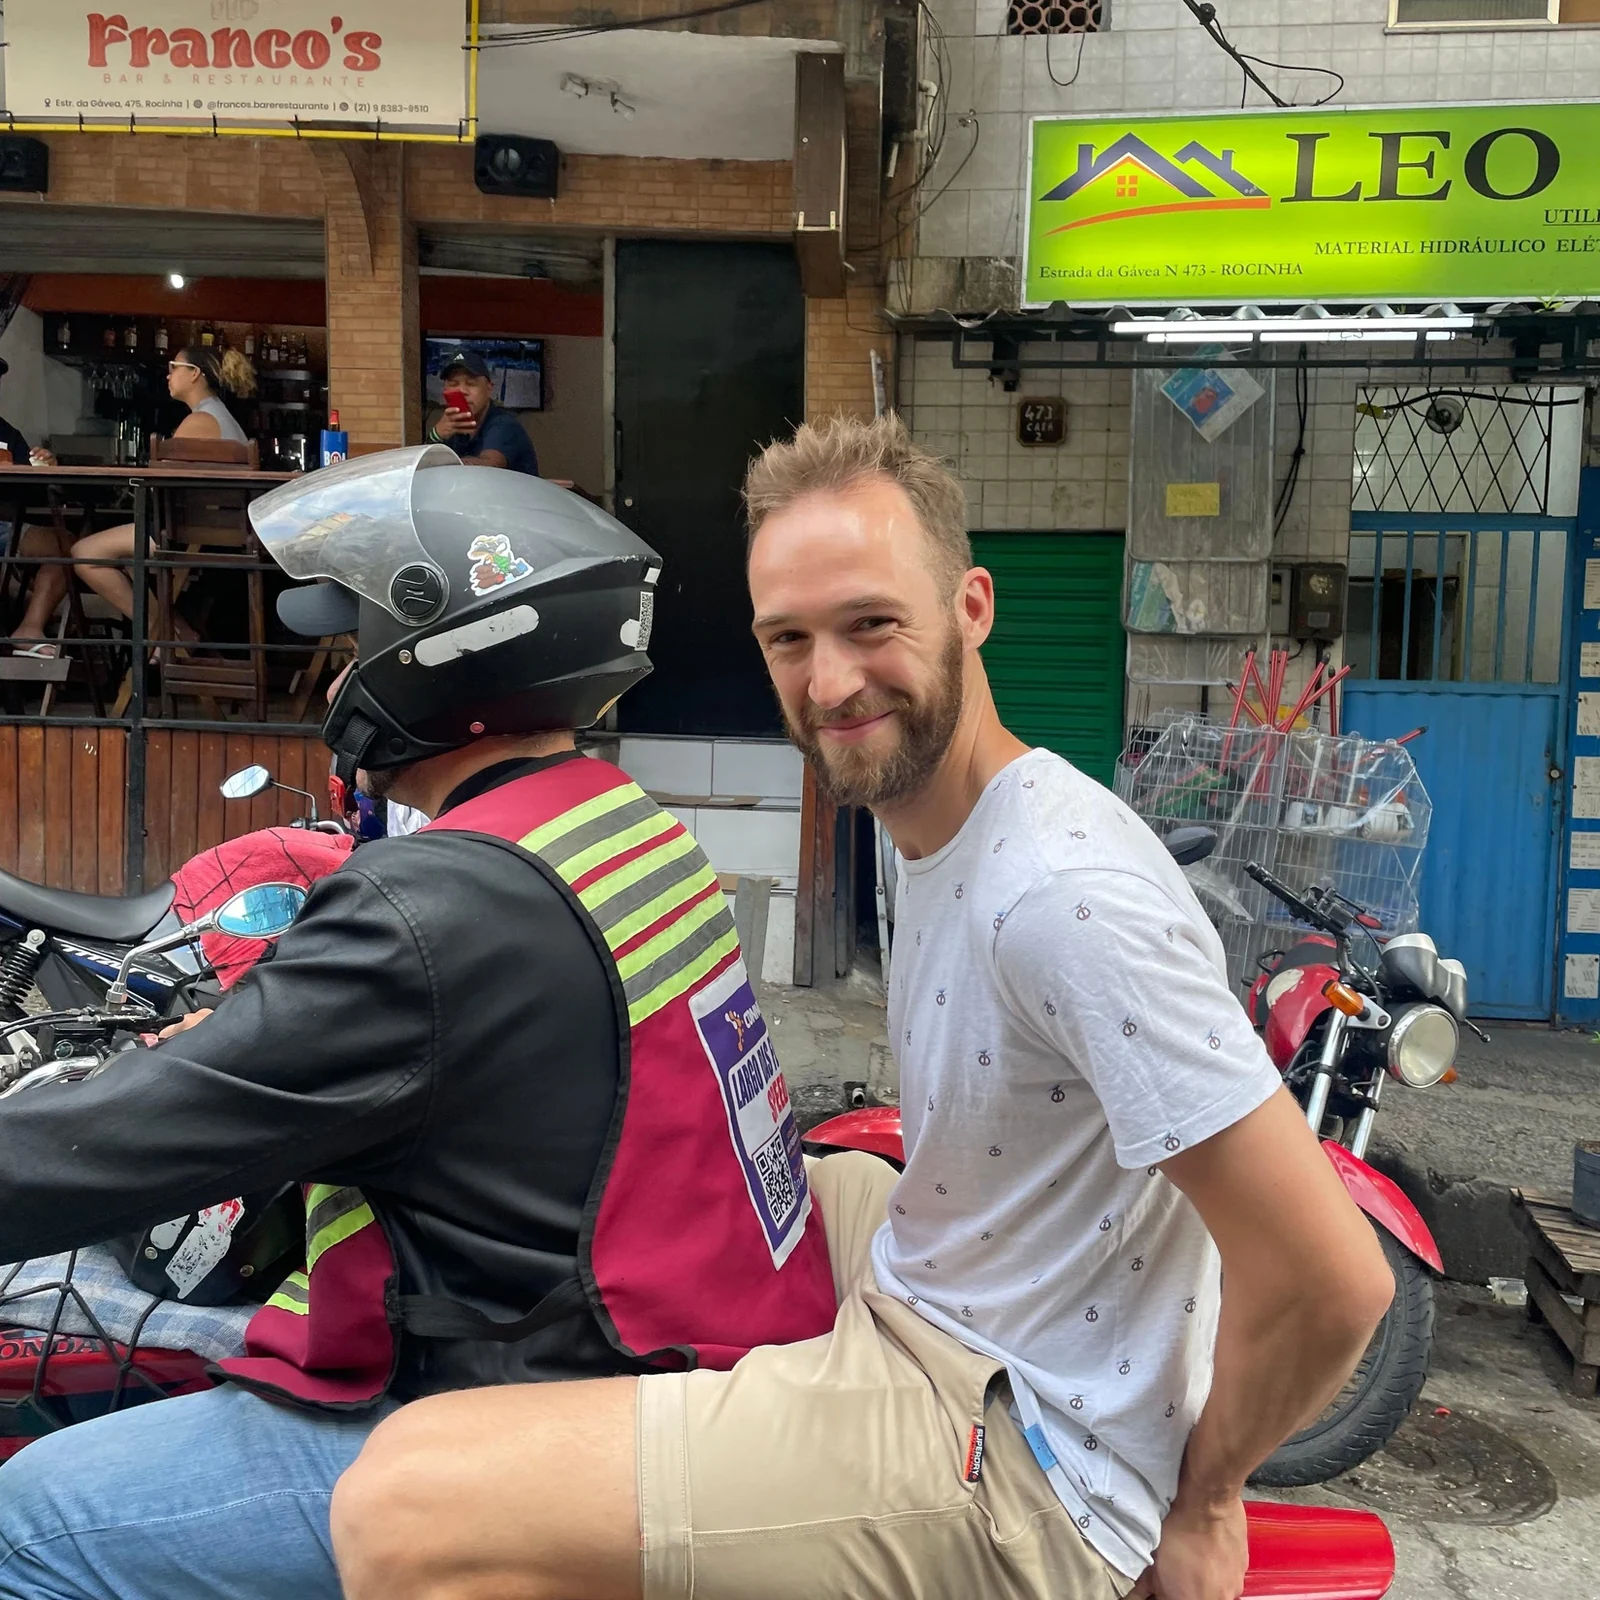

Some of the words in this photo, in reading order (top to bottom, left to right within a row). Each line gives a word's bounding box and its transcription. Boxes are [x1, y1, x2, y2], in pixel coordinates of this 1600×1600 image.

[86, 12, 382, 71] Franco's
[103, 72, 144, 84] BAR
[162, 73, 172, 84] &
[192, 73, 366, 88] RESTAURANTE
[55, 98, 75, 108] Estr.
[76, 98, 89, 108] da
[91, 98, 123, 109] Gávea,
[145, 99, 183, 108] Rocinha
[354, 102, 371, 114] (21)
[1280, 127, 1561, 203] LEO
[1314, 240, 1415, 256] MATERIAL
[1420, 236, 1546, 254] HIDRÁULICO
[1040, 266, 1093, 279] Estrada
[1097, 265, 1113, 278] da
[1118, 264, 1161, 278] Gávea
[1164, 264, 1179, 277] N
[1182, 264, 1206, 277] 473
[1221, 263, 1304, 277] ROCINHA
[732, 1054, 764, 1110] LARGO
[972, 1428, 983, 1476] SUPERDRY
